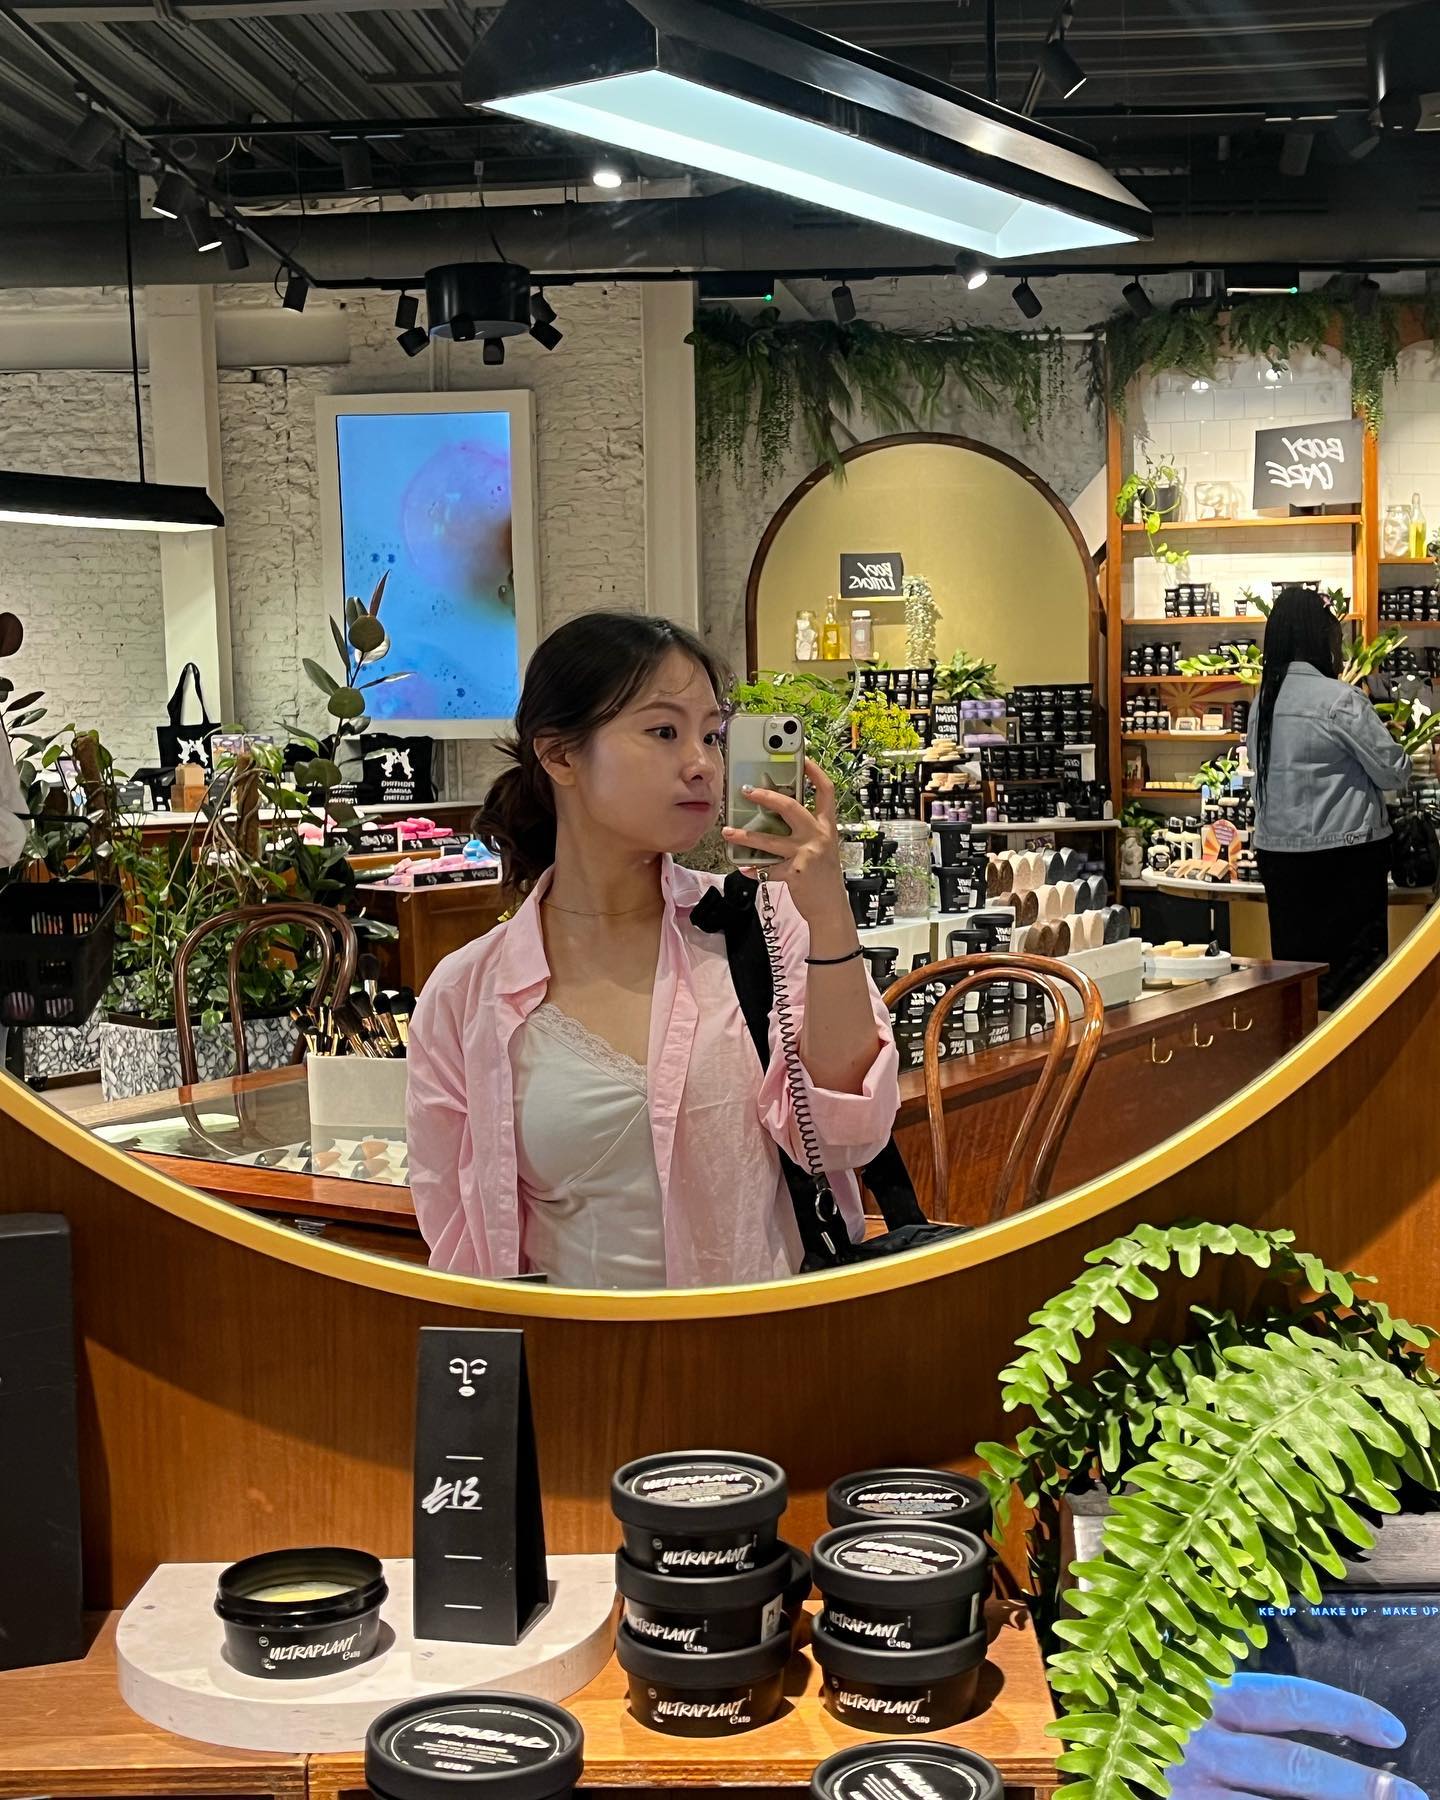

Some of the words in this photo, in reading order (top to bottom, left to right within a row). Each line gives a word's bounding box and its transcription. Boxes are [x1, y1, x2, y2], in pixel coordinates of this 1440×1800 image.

[662, 1543, 752, 1566] ULTRAPLANT
[1311, 1606, 1346, 1617] MAKE
[1351, 1606, 1368, 1617] UP
[1382, 1606, 1418, 1617] MAKE
[1422, 1606, 1440, 1617] UP
[829, 1610, 905, 1639] ULTRAPLANT
[269, 1632, 358, 1661] ULTRAPLANT
[657, 1696, 748, 1718] ULTRAPLANT
[839, 1690, 926, 1715] ULTRAPLANT
